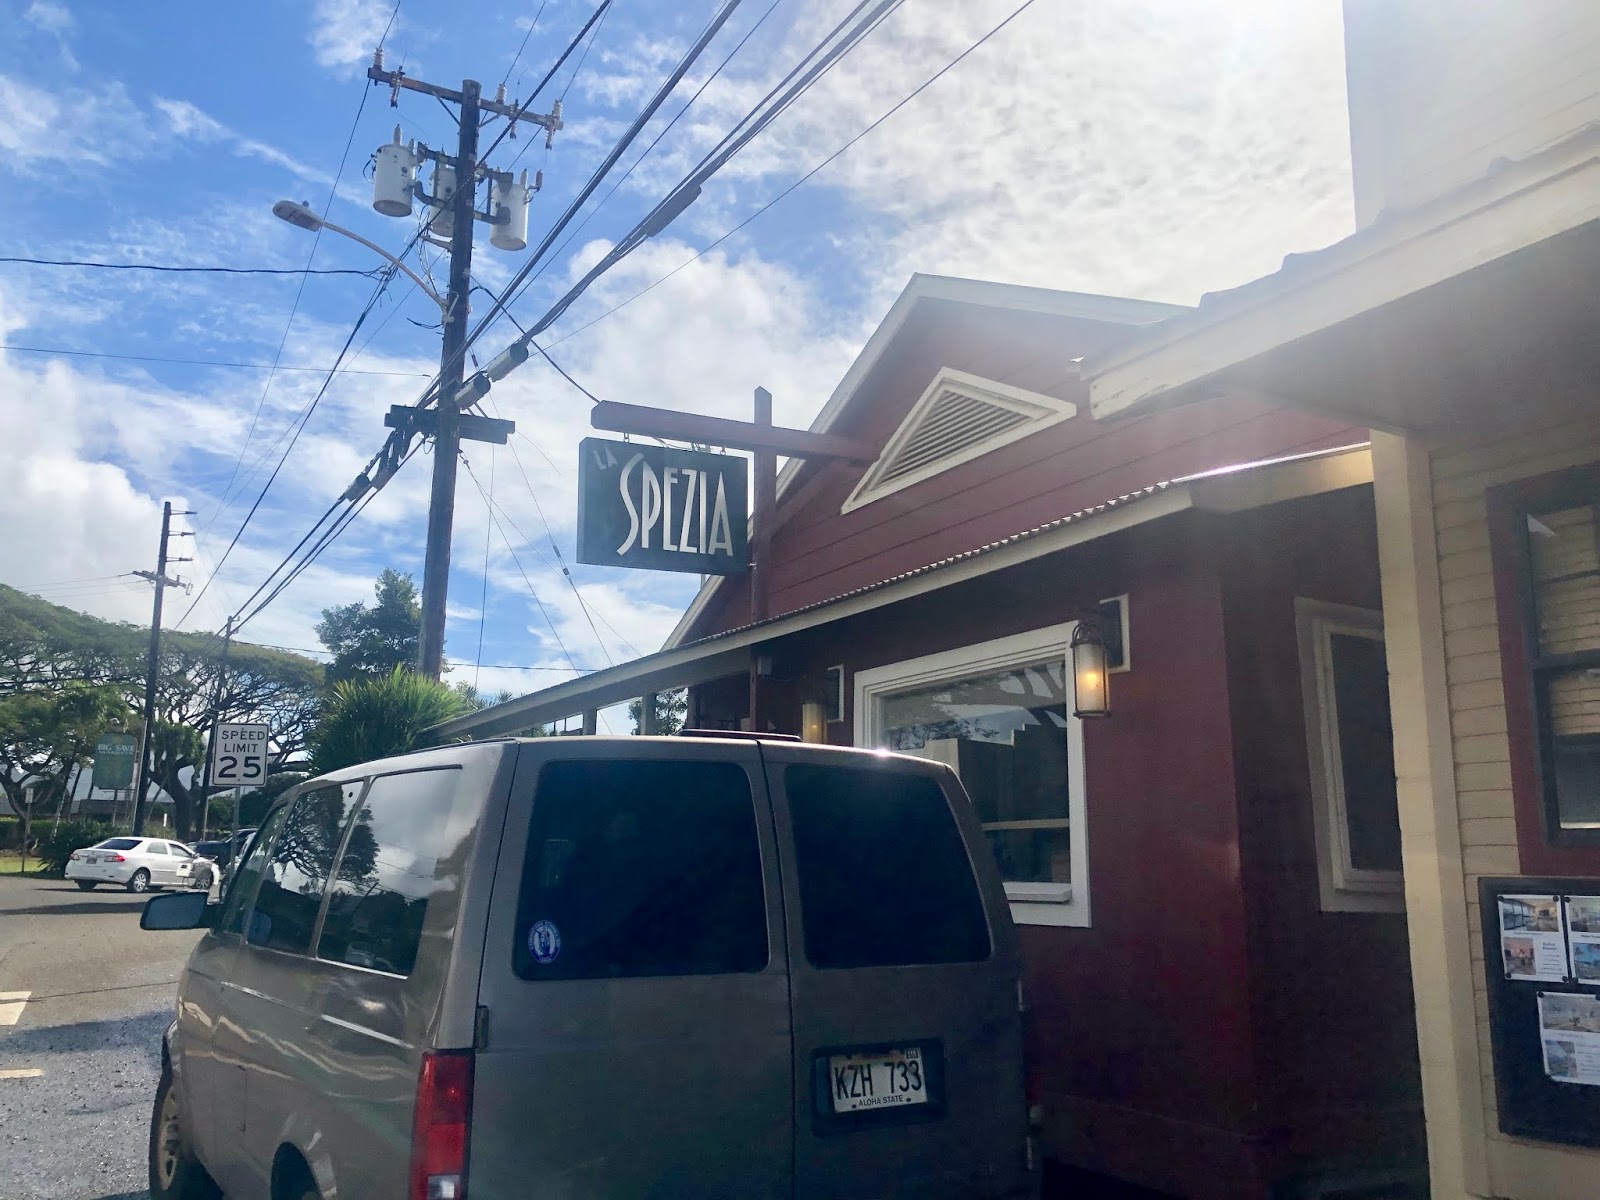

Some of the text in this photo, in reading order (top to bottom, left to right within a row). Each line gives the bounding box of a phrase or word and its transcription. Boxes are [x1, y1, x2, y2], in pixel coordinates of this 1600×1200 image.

[594, 446, 618, 470] LA
[617, 453, 734, 557] SPEZIA
[221, 730, 265, 740] SPEED
[98, 743, 134, 752] BIG SAVE
[223, 743, 258, 753] LIMIT
[218, 755, 261, 778] 25
[834, 1060, 922, 1100] KZH 733
[858, 1095, 904, 1107] ALOHA STATE
